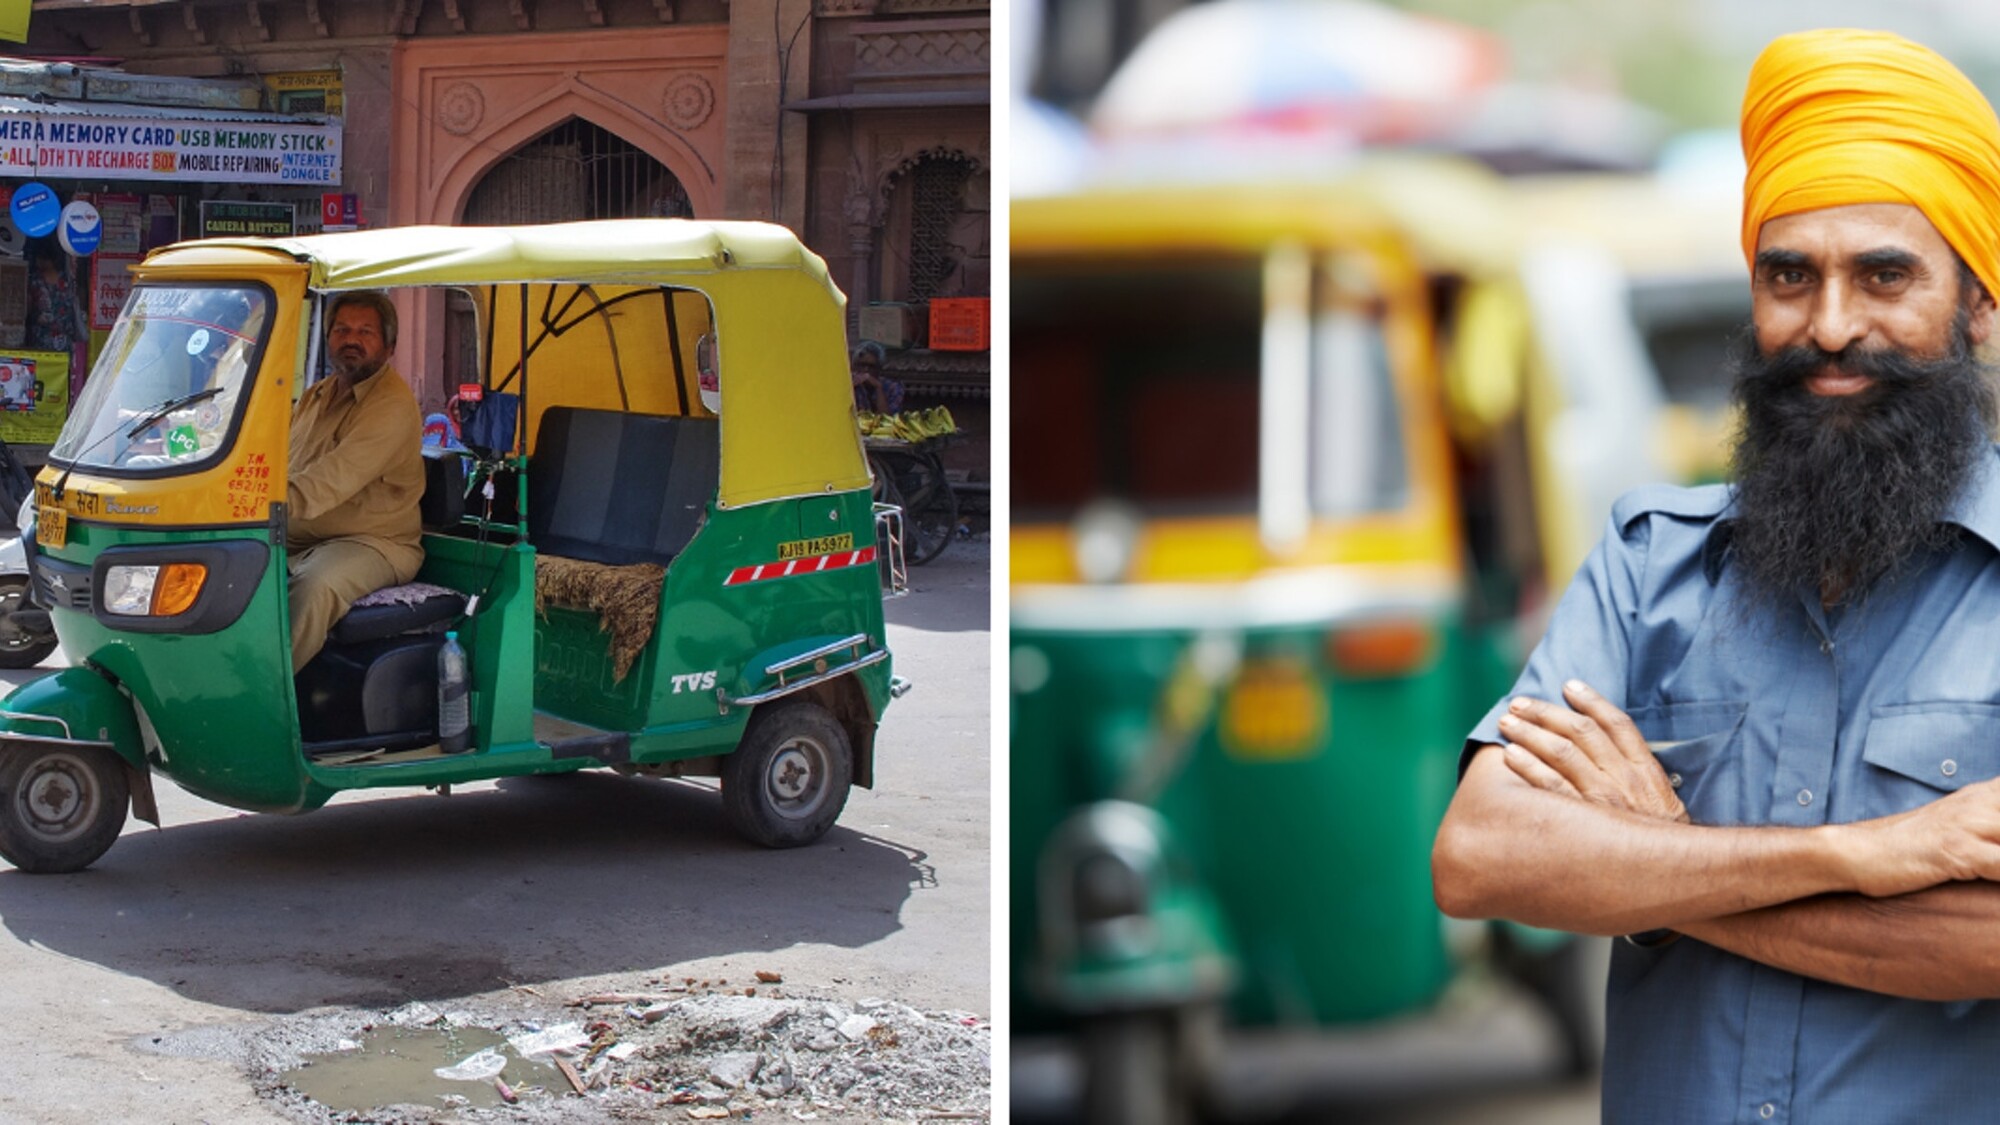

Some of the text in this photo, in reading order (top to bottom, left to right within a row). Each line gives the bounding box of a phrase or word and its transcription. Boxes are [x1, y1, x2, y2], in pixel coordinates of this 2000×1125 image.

[50, 122, 128, 144] MEMORY
[132, 126, 175, 146] CARD
[180, 129, 210, 147] USB
[214, 130, 277, 150] MEMORY
[280, 134, 326, 151] STICK
[8, 148, 33, 166] ALL
[39, 148, 65, 167] DTH
[68, 149, 84, 167] TV
[86, 150, 149, 169] RECHARGE
[152, 152, 176, 170] BOX
[178, 154, 220, 171] MOBILE
[223, 155, 279, 173] REPAIRING
[282, 153, 336, 168] INTERNET
[282, 168, 330, 181] DONGLE
[206, 220, 245, 232] CAMERA
[170, 428, 195, 450] LPG
[779, 534, 851, 559] RJ19 PA5977
[671, 671, 718, 694] TVS
